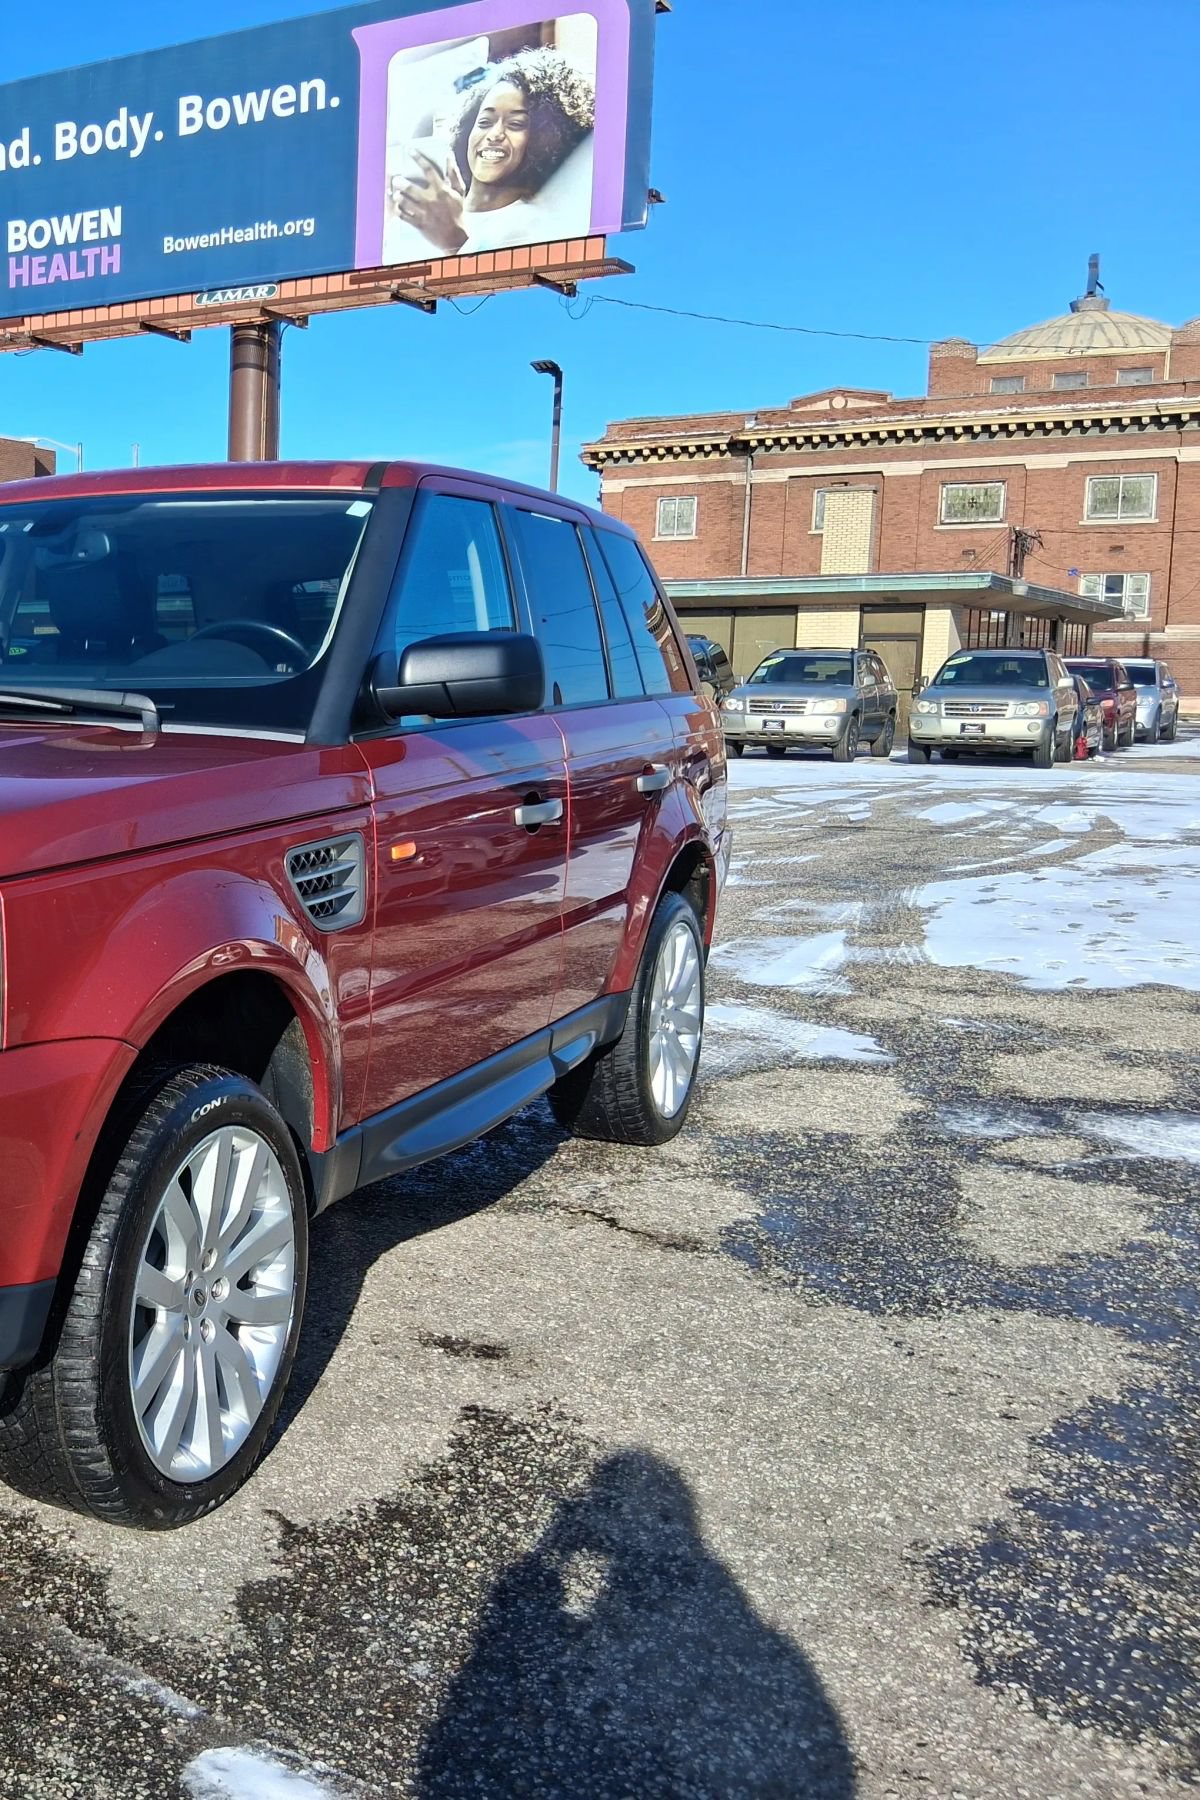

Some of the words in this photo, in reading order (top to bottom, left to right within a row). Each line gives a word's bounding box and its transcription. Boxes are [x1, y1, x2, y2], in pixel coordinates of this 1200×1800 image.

[55, 106, 164, 158] Body.
[178, 78, 340, 136] Bowen.
[7, 205, 122, 253] BOWEN
[163, 217, 315, 254] BowenHealth.org
[8, 244, 121, 288] HEALTH
[201, 286, 270, 305] LAMAR
